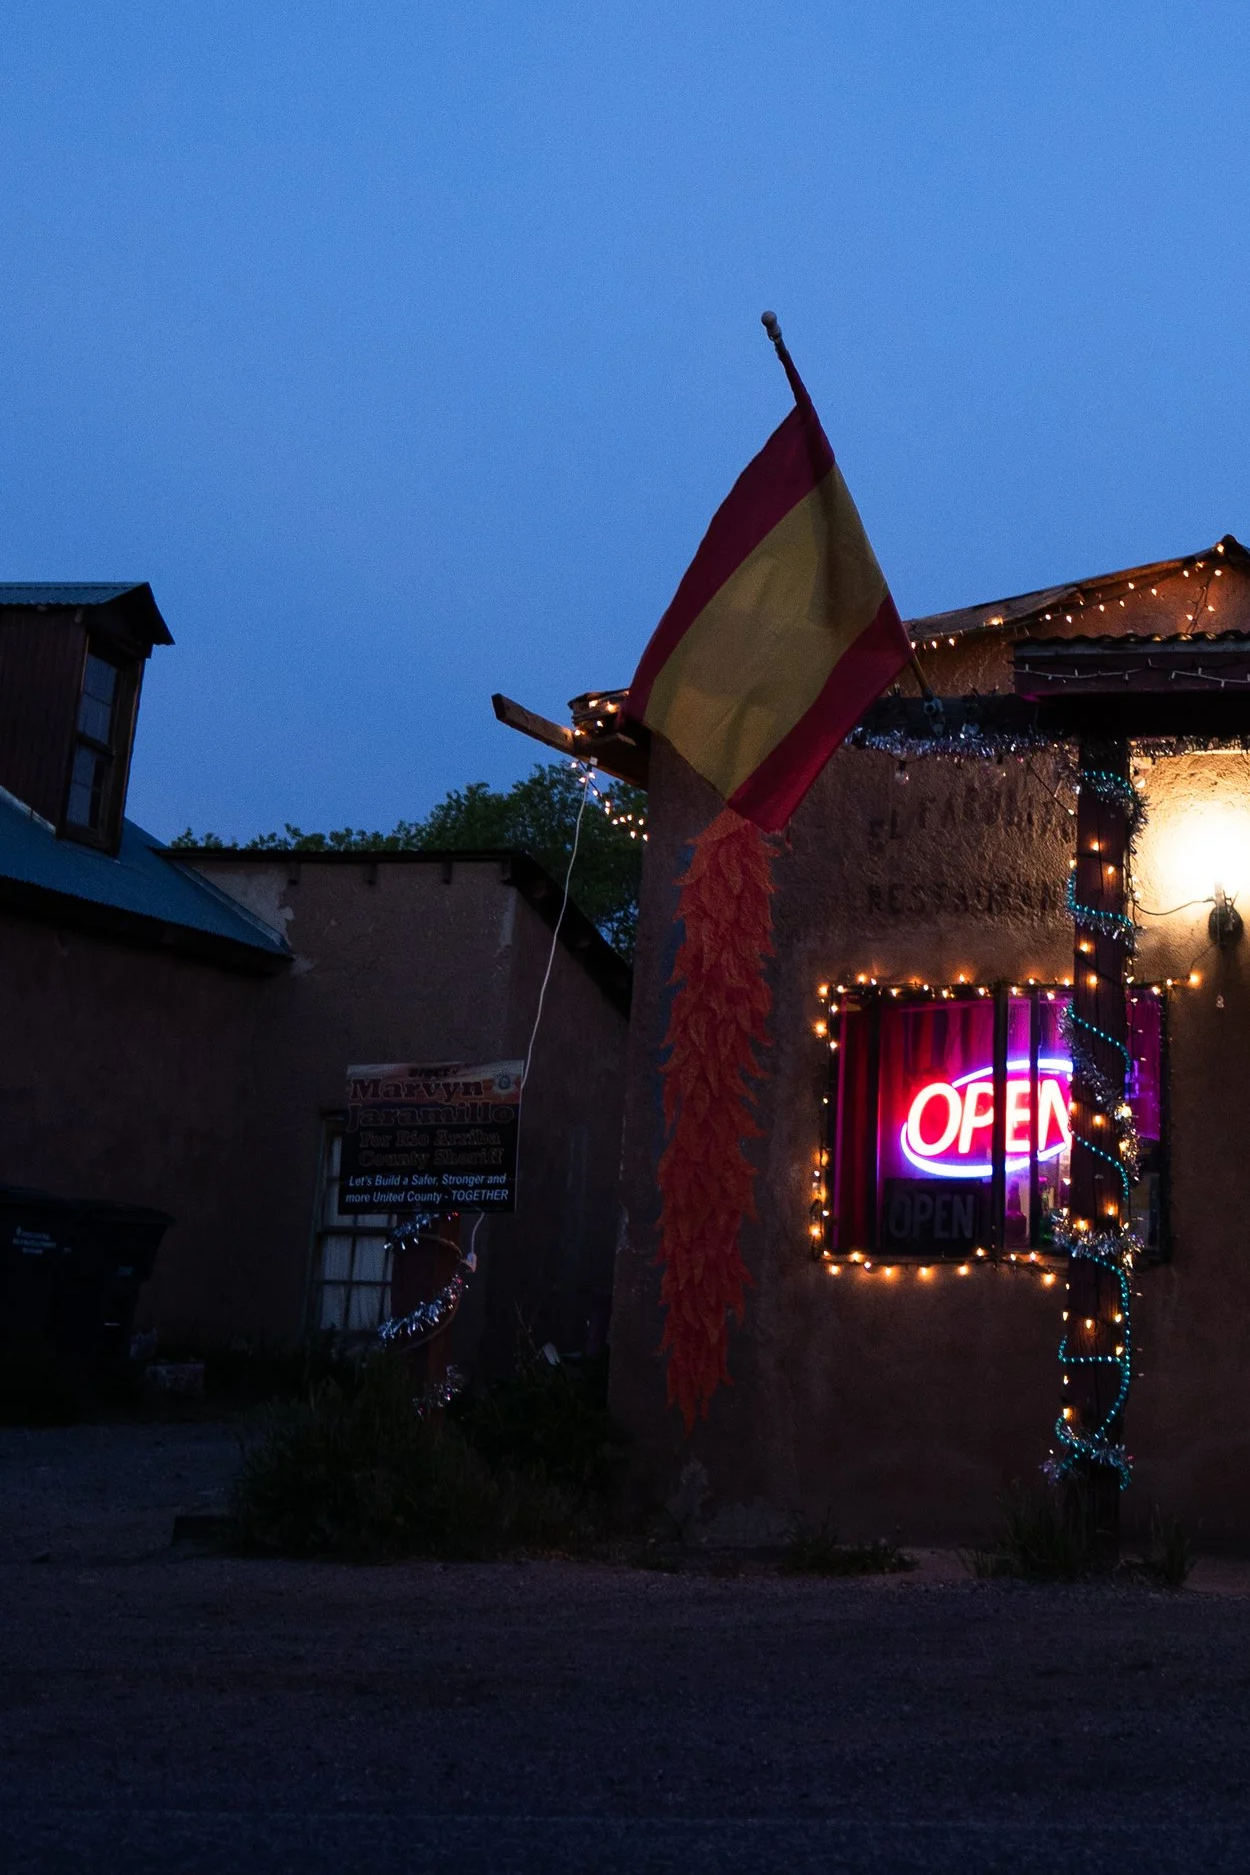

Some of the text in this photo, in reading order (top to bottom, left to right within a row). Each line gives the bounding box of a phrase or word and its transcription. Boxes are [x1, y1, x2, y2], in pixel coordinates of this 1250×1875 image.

[349, 1078, 486, 1102] Marvyn
[347, 1101, 515, 1133] Jaramillo
[907, 1079, 1072, 1156] OPEN
[359, 1127, 502, 1148] For Rio Arriba
[358, 1146, 505, 1170] County Sheriff
[348, 1173, 507, 1188] Let's Build a Safer, Stronger and
[345, 1192, 370, 1203] more
[372, 1190, 404, 1203] United
[406, 1190, 443, 1205] County
[451, 1188, 509, 1202] TOGETHER
[888, 1193, 975, 1239] OPEN
